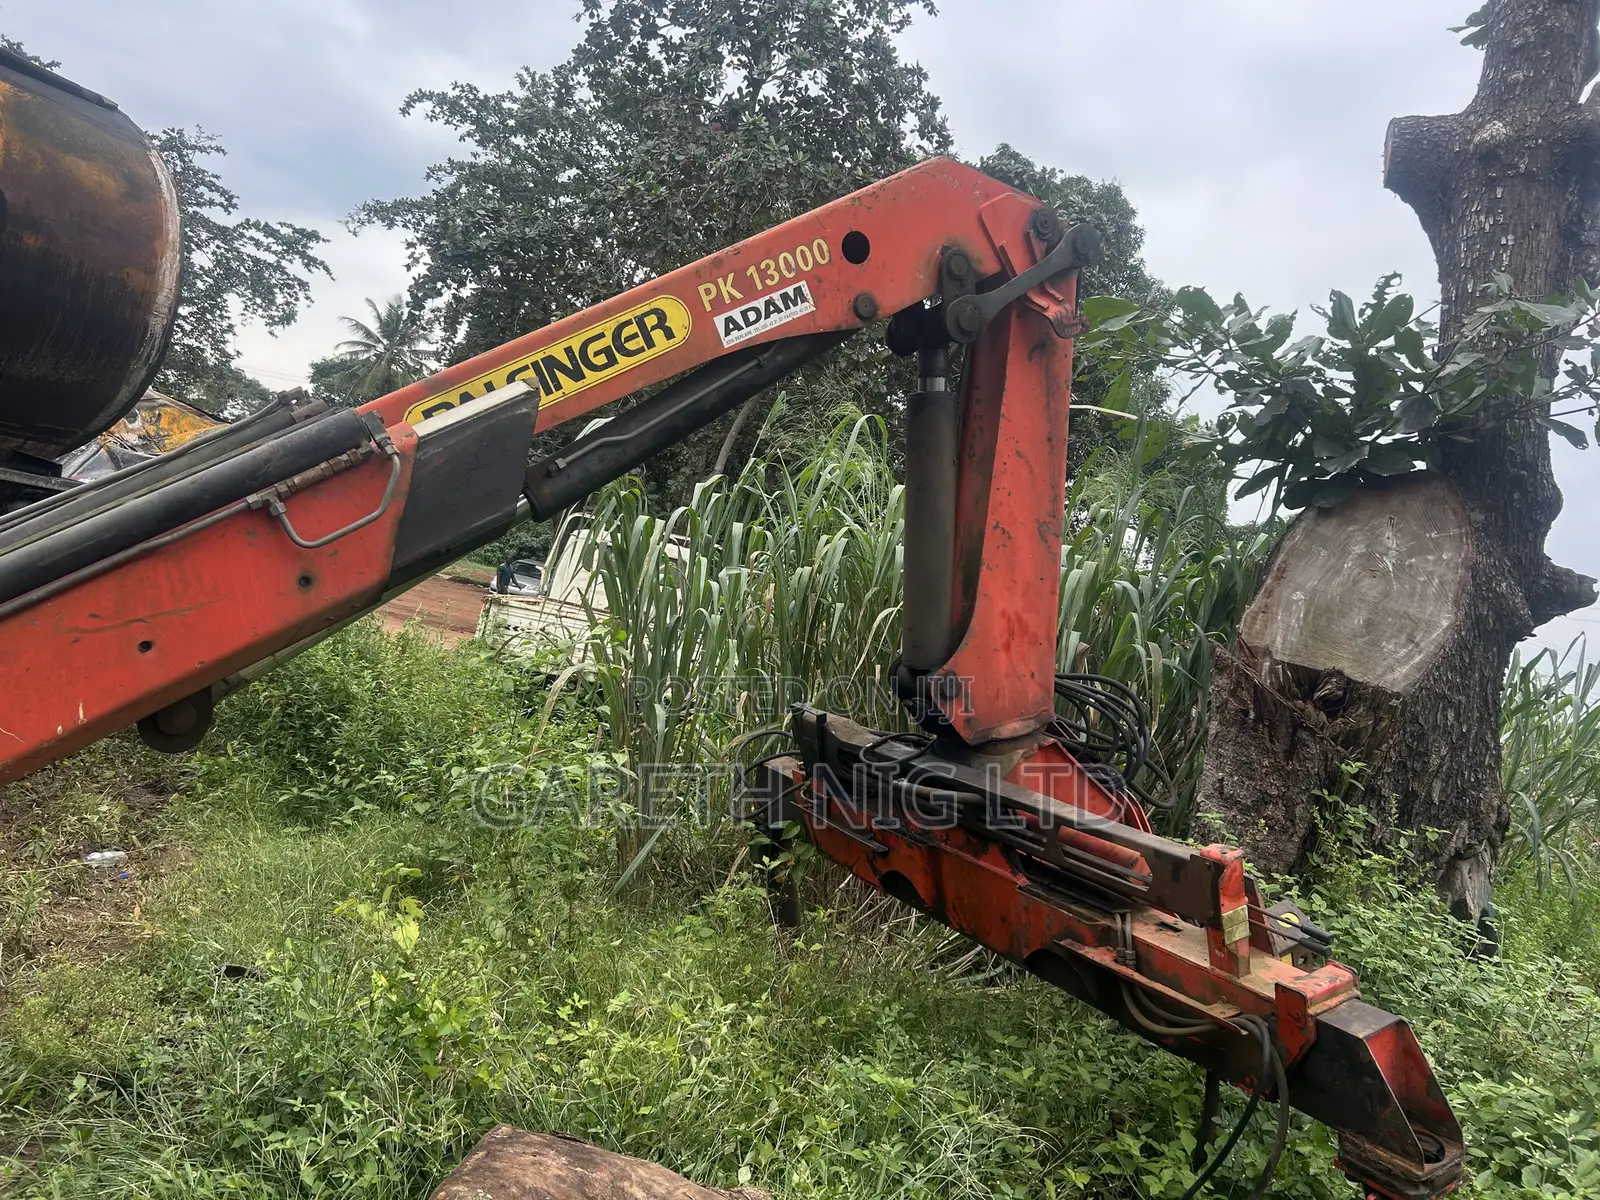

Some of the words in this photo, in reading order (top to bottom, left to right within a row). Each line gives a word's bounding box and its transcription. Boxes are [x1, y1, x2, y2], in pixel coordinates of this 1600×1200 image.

[697, 272, 744, 312] PK
[746, 238, 830, 291] 13000
[724, 285, 806, 338] ADAM
[421, 307, 676, 420] INGER
